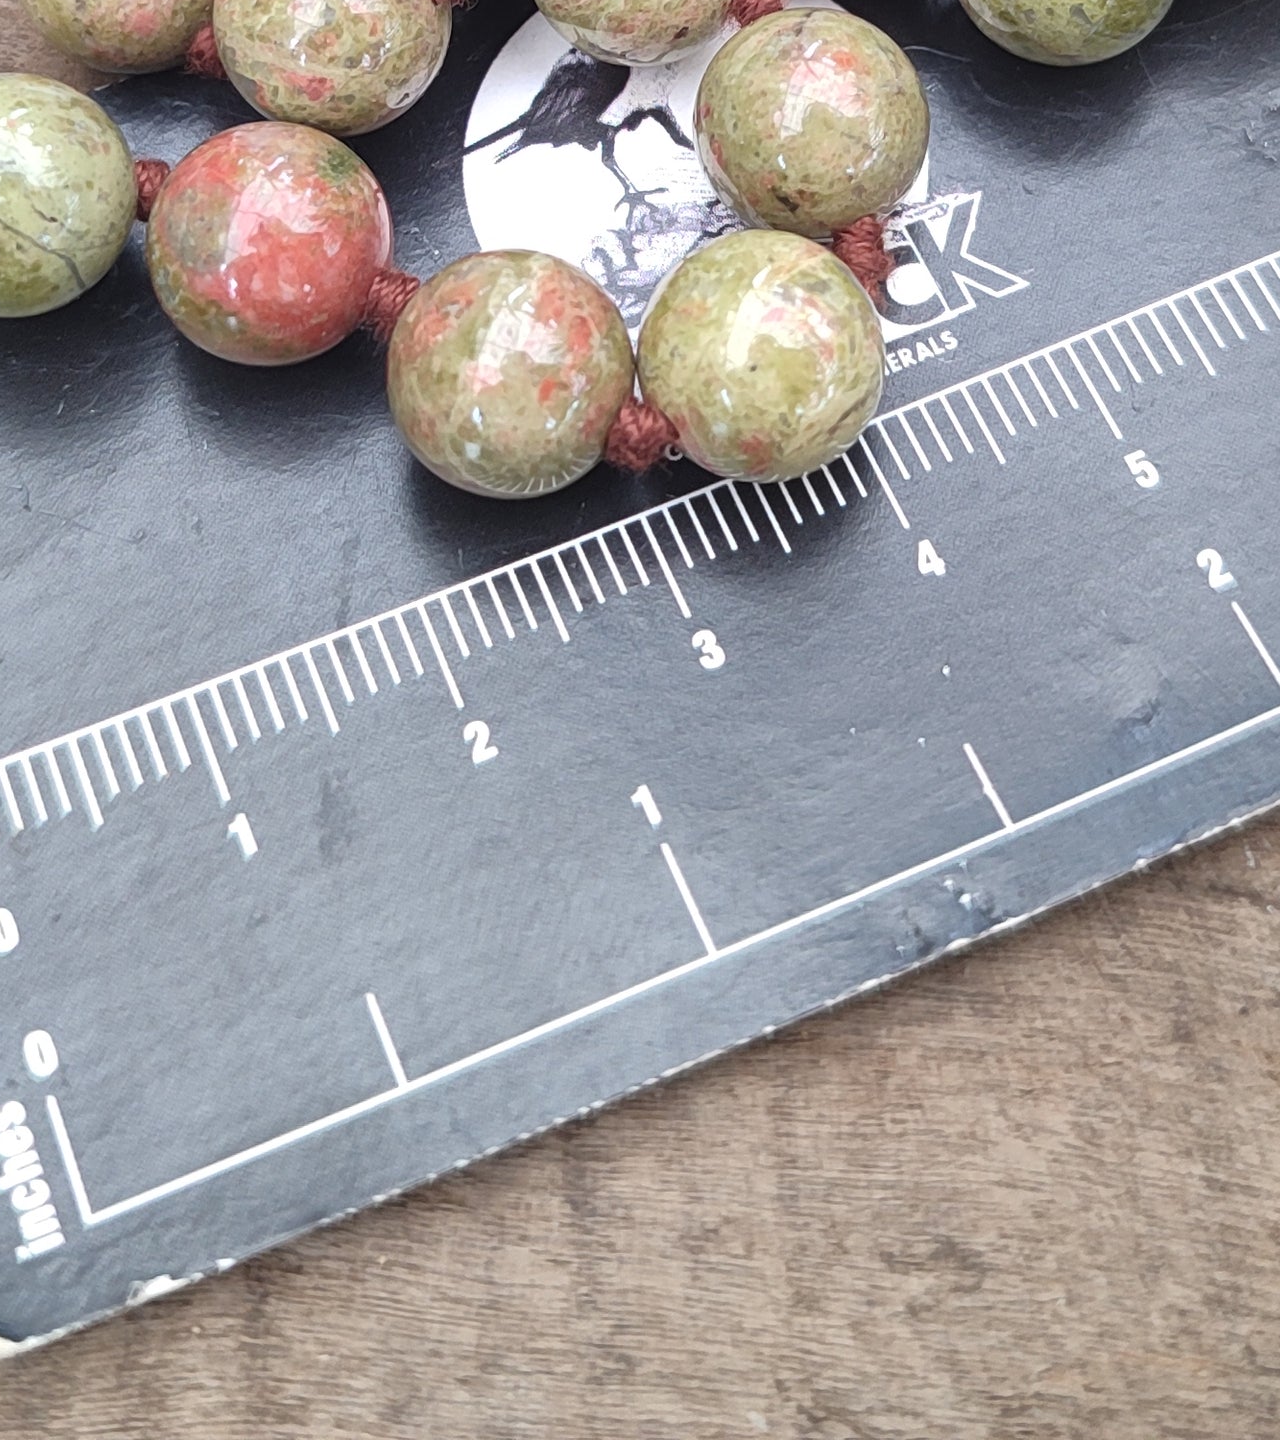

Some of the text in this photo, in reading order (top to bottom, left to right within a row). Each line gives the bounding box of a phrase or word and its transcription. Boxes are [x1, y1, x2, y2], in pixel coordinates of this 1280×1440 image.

[23, 1029, 59, 1078] 0
[630, 784, 662, 828] 1
[1195, 548, 1236, 591] 2
[227, 812, 258, 860] 1
[463, 720, 499, 765] 2
[691, 629, 726, 670] 3
[917, 538, 946, 577] 4
[1123, 449, 1160, 489] 5
